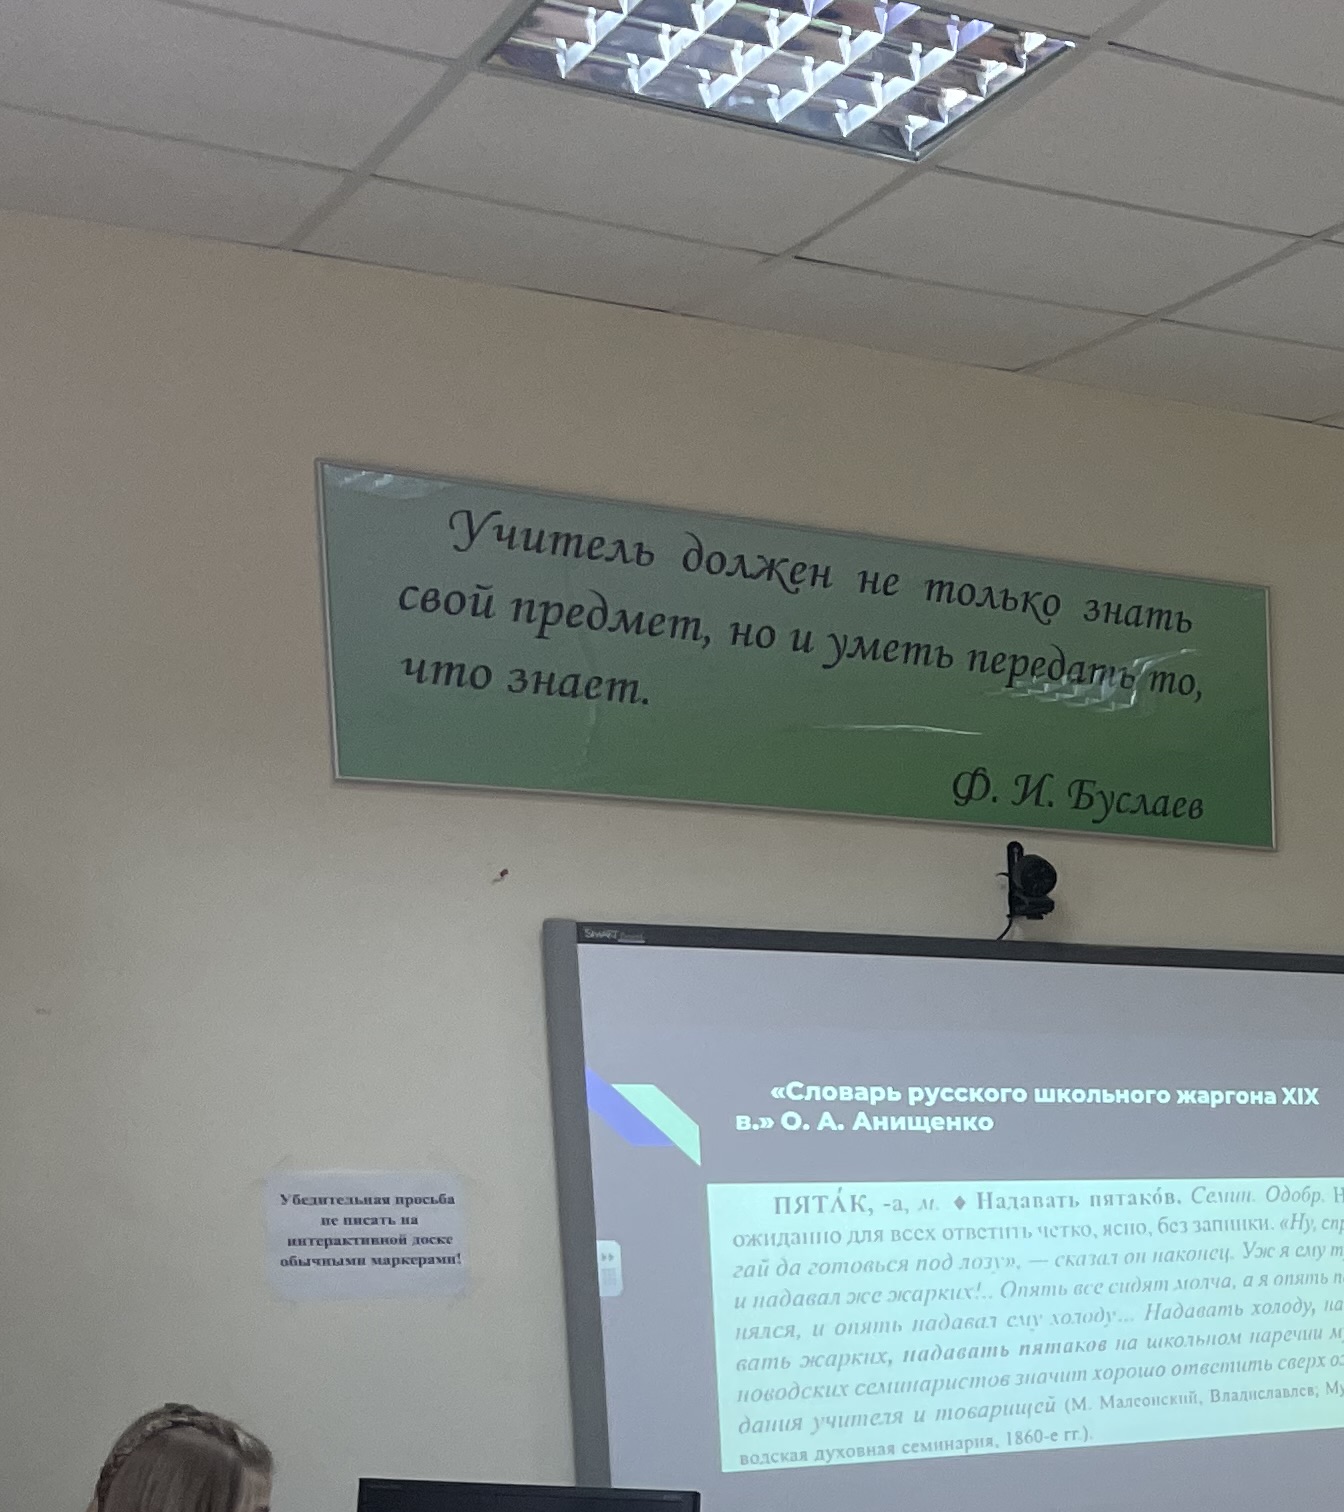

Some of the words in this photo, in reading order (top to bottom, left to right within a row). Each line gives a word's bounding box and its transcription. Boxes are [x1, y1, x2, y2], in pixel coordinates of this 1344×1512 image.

[450, 507, 655, 567] Учитель
[682, 532, 833, 594] должен
[857, 565, 899, 597] не
[923, 575, 1060, 626] только
[1084, 595, 1192, 635] знать
[398, 581, 495, 622] свой
[511, 591, 712, 652] предмет,
[730, 620, 775, 651] но
[791, 628, 814, 656] и
[822, 631, 953, 671] уметь
[966, 639, 1140, 698] передать
[1148, 663, 1202, 704] то,
[402, 655, 491, 692] что
[507, 663, 649, 707] знает.
[952, 766, 998, 807] Ф.
[1011, 774, 1054, 810] И.
[1067, 778, 1203, 824] Буслаев
[771, 1081, 901, 1109] «Словарь
[908, 1081, 1027, 1111] русского
[1034, 1084, 1170, 1107] школьного
[1175, 1084, 1276, 1111] жаргона
[1282, 1086, 1319, 1106] XIX
[735, 1113, 773, 1132] в.»
[781, 1112, 809, 1132] О.
[817, 1112, 845, 1132] А.
[852, 1112, 994, 1136] Анищенко
[280, 1194, 390, 1206] Убедительная
[395, 1194, 455, 1207] просьба
[977, 1190, 1080, 1210] Надавать
[1191, 1186, 1255, 1204] Семин.
[1266, 1185, 1325, 1207] Одобр.
[321, 1217, 338, 1226] не
[343, 1217, 396, 1226] писать
[401, 1216, 418, 1225] на
[733, 1229, 841, 1248] ожиданно
[847, 1229, 884, 1246] для
[891, 1228, 936, 1242] всех
[942, 1225, 1032, 1241] ответить
[1036, 1223, 1098, 1239] четко,
[1102, 1221, 1153, 1237] ясно,
[1158, 1216, 1188, 1233] без
[1193, 1216, 1274, 1233] запинки.
[1279, 1213, 1317, 1232] «Ну,
[288, 1234, 407, 1249] интерактивной
[412, 1235, 453, 1246] доске
[280, 1256, 366, 1267] обычными
[371, 1253, 461, 1268] маркерами!
[733, 1258, 769, 1279] гай
[776, 1258, 800, 1276] да
[807, 1257, 908, 1276] готовься
[915, 1253, 953, 1272] под
[1055, 1251, 1118, 1267] сказал
[1124, 1251, 1146, 1265] он
[1152, 1244, 1235, 1263] наконец.
[1242, 1242, 1275, 1260] Уж
[1279, 1244, 1289, 1258] я
[1295, 1244, 1325, 1260] ему
[734, 1296, 746, 1309] и
[753, 1292, 840, 1308] надавал
[846, 1292, 880, 1305] же
[1000, 1280, 1067, 1301] Опять
[1074, 1282, 1103, 1296] все
[1109, 1277, 1169, 1295] сидят
[1173, 1274, 1236, 1292] молча,
[1242, 1275, 1253, 1288] а
[1257, 1274, 1268, 1287] я
[1274, 1272, 1328, 1286] опять
[736, 1324, 801, 1341] нялся,
[812, 1324, 824, 1338] и
[834, 1321, 902, 1337] опять
[911, 1313, 997, 1333] надавал
[1007, 1313, 1043, 1332] ему
[1144, 1301, 1243, 1322] Надавать
[1250, 1297, 1316, 1317] холоду,
[736, 1356, 791, 1372] вать
[800, 1349, 893, 1372] жарких,
[902, 1342, 1009, 1363] надавать
[1019, 1338, 1108, 1357] пятаков
[1115, 1338, 1138, 1351] на
[1146, 1331, 1242, 1349] школьном
[1249, 1327, 1323, 1348] наречии
[737, 1384, 848, 1403] новодских
[855, 1375, 1010, 1397] семинаристов
[1015, 1366, 1088, 1388] значит
[1093, 1363, 1165, 1385] хорошо
[1171, 1358, 1273, 1377] ответить
[1278, 1355, 1326, 1370] сверх
[739, 1415, 803, 1434] дания
[810, 1409, 903, 1435] учителя
[914, 1409, 926, 1422] и
[935, 1396, 1056, 1421] товарищей
[1065, 1397, 1092, 1414] (М.
[740, 1450, 808, 1465] водская
[814, 1442, 895, 1463] духовная
[902, 1435, 999, 1455] семинария,
[1006, 1431, 1059, 1446] 1860-е
